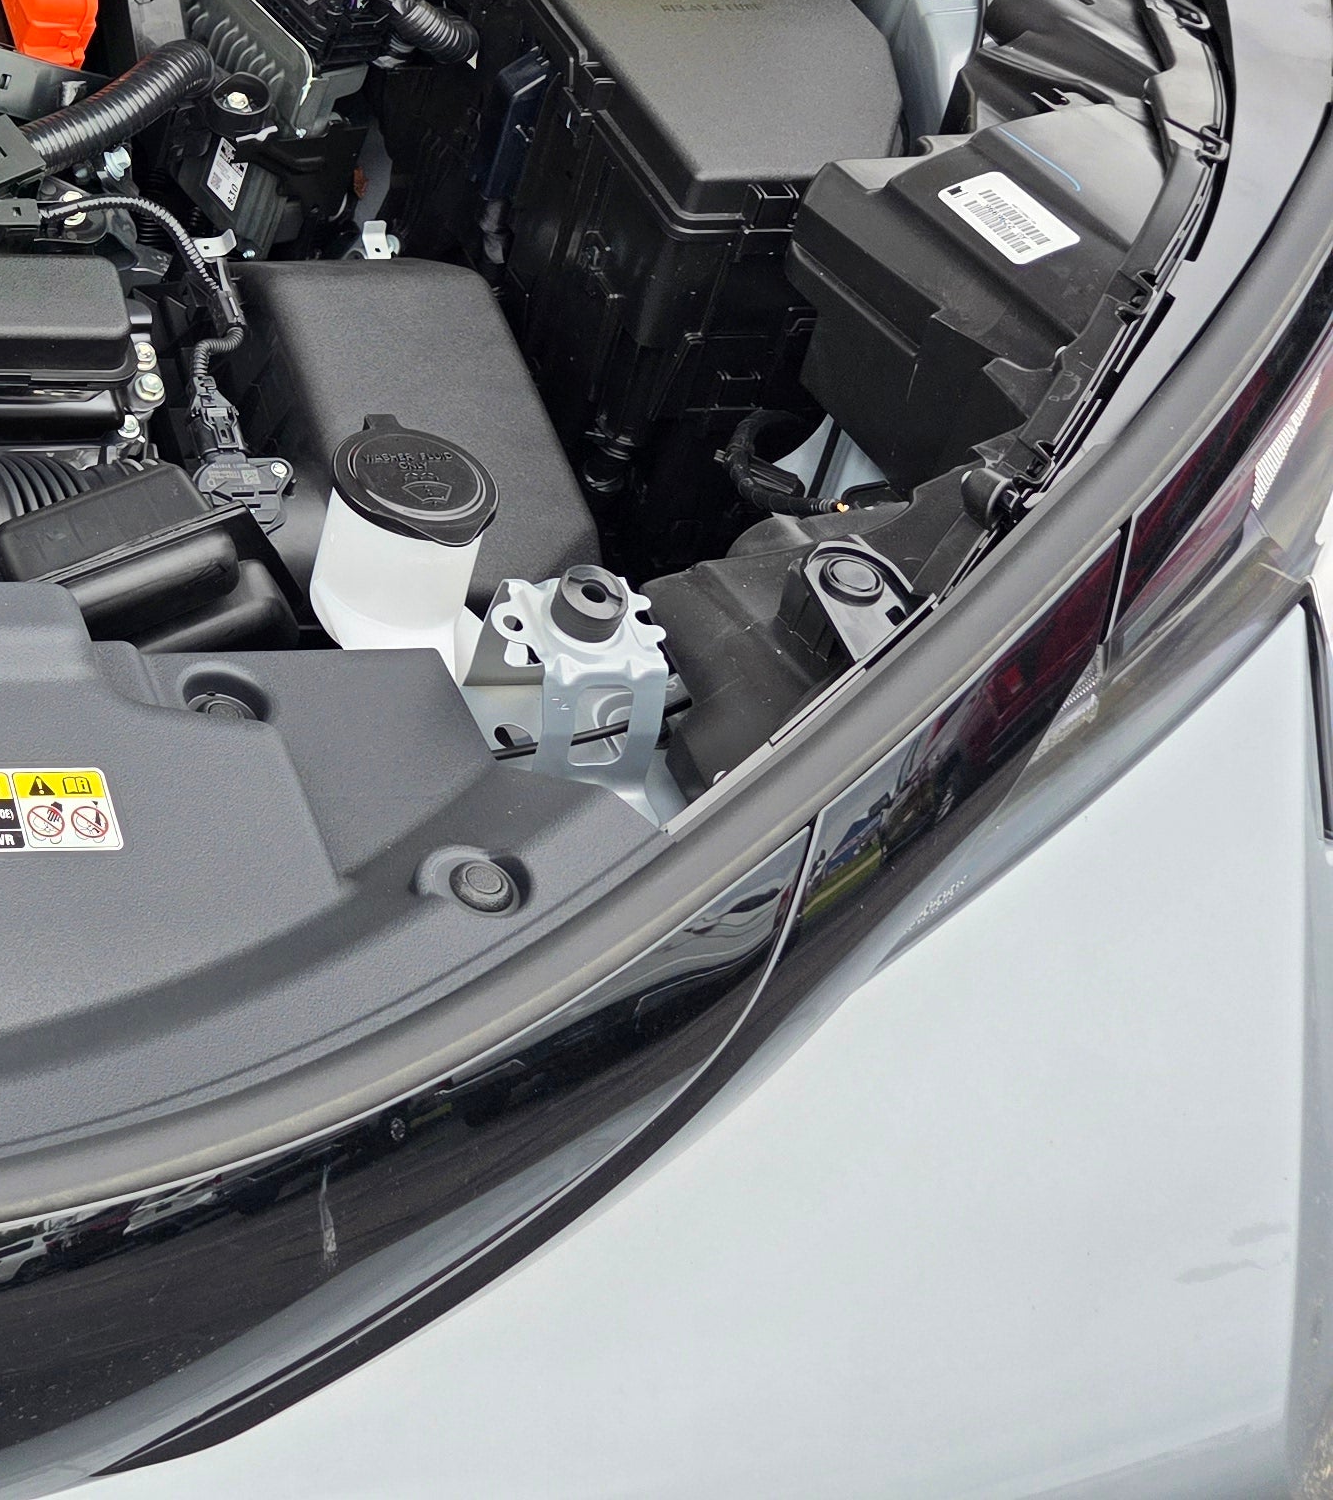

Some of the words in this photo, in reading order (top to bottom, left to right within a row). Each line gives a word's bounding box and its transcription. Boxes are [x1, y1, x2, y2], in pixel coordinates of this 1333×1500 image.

[363, 452, 415, 464] WASHER
[419, 451, 453, 462] FLUID
[398, 462, 428, 471] ONLY
